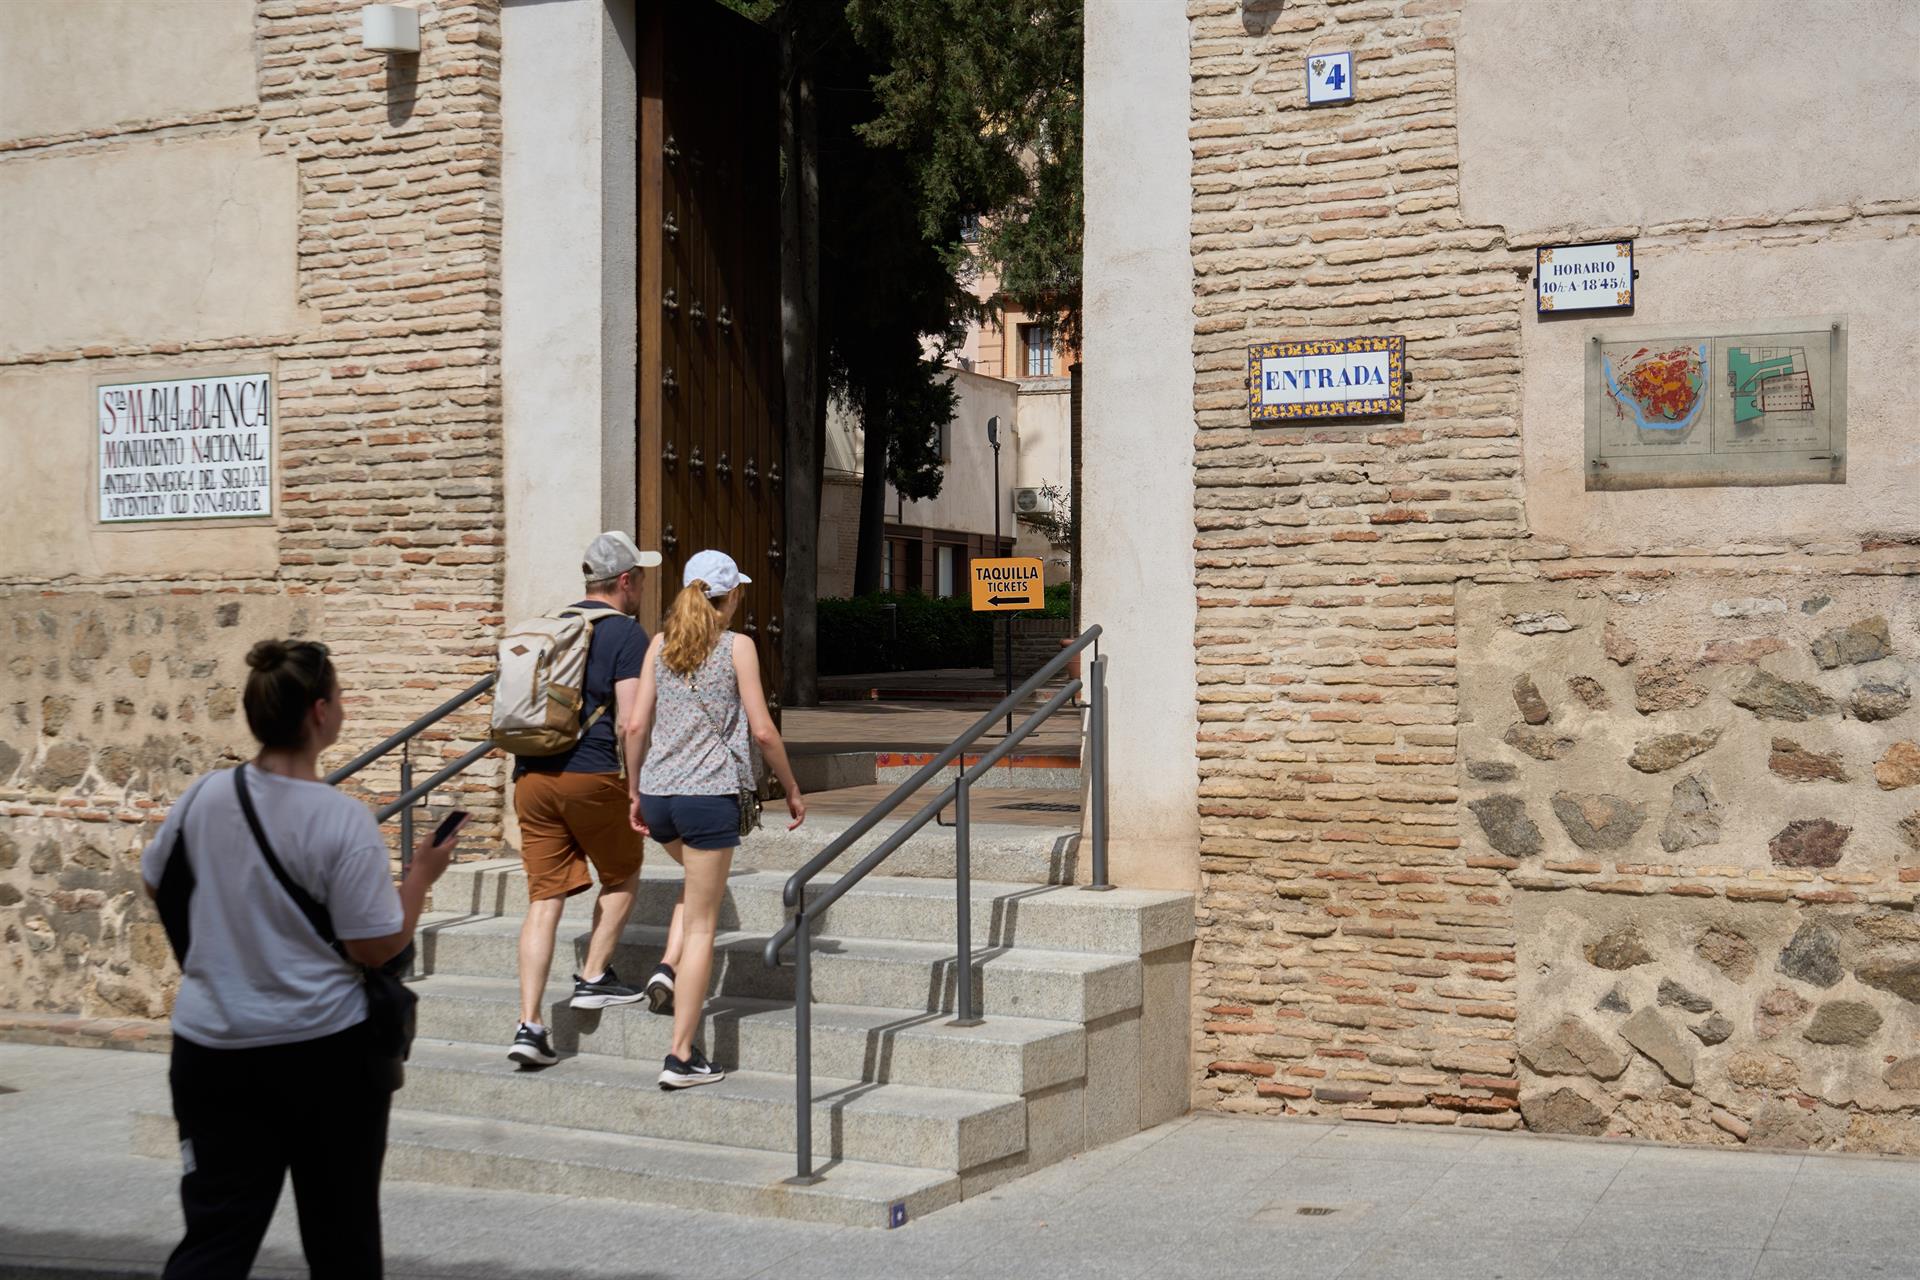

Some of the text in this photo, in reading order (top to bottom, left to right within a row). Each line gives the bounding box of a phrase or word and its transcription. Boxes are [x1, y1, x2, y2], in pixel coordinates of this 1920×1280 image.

[1325, 64, 1346, 90] 4
[1554, 261, 1615, 276] HORARIO
[1266, 365, 1386, 390] ENTRADA
[126, 386, 180, 434] MARIA
[192, 380, 268, 430] BLANCA
[104, 433, 265, 469] MONUMENTO NACIONAL
[145, 470, 194, 492] SINAGOGA
[200, 469, 216, 490] DEL
[221, 467, 250, 488] SIGLO
[171, 494, 189, 514] OLD
[193, 490, 262, 513] SYNAGOGUE
[976, 567, 1038, 580] TAQUILLA
[987, 582, 1028, 592] TICKETS
